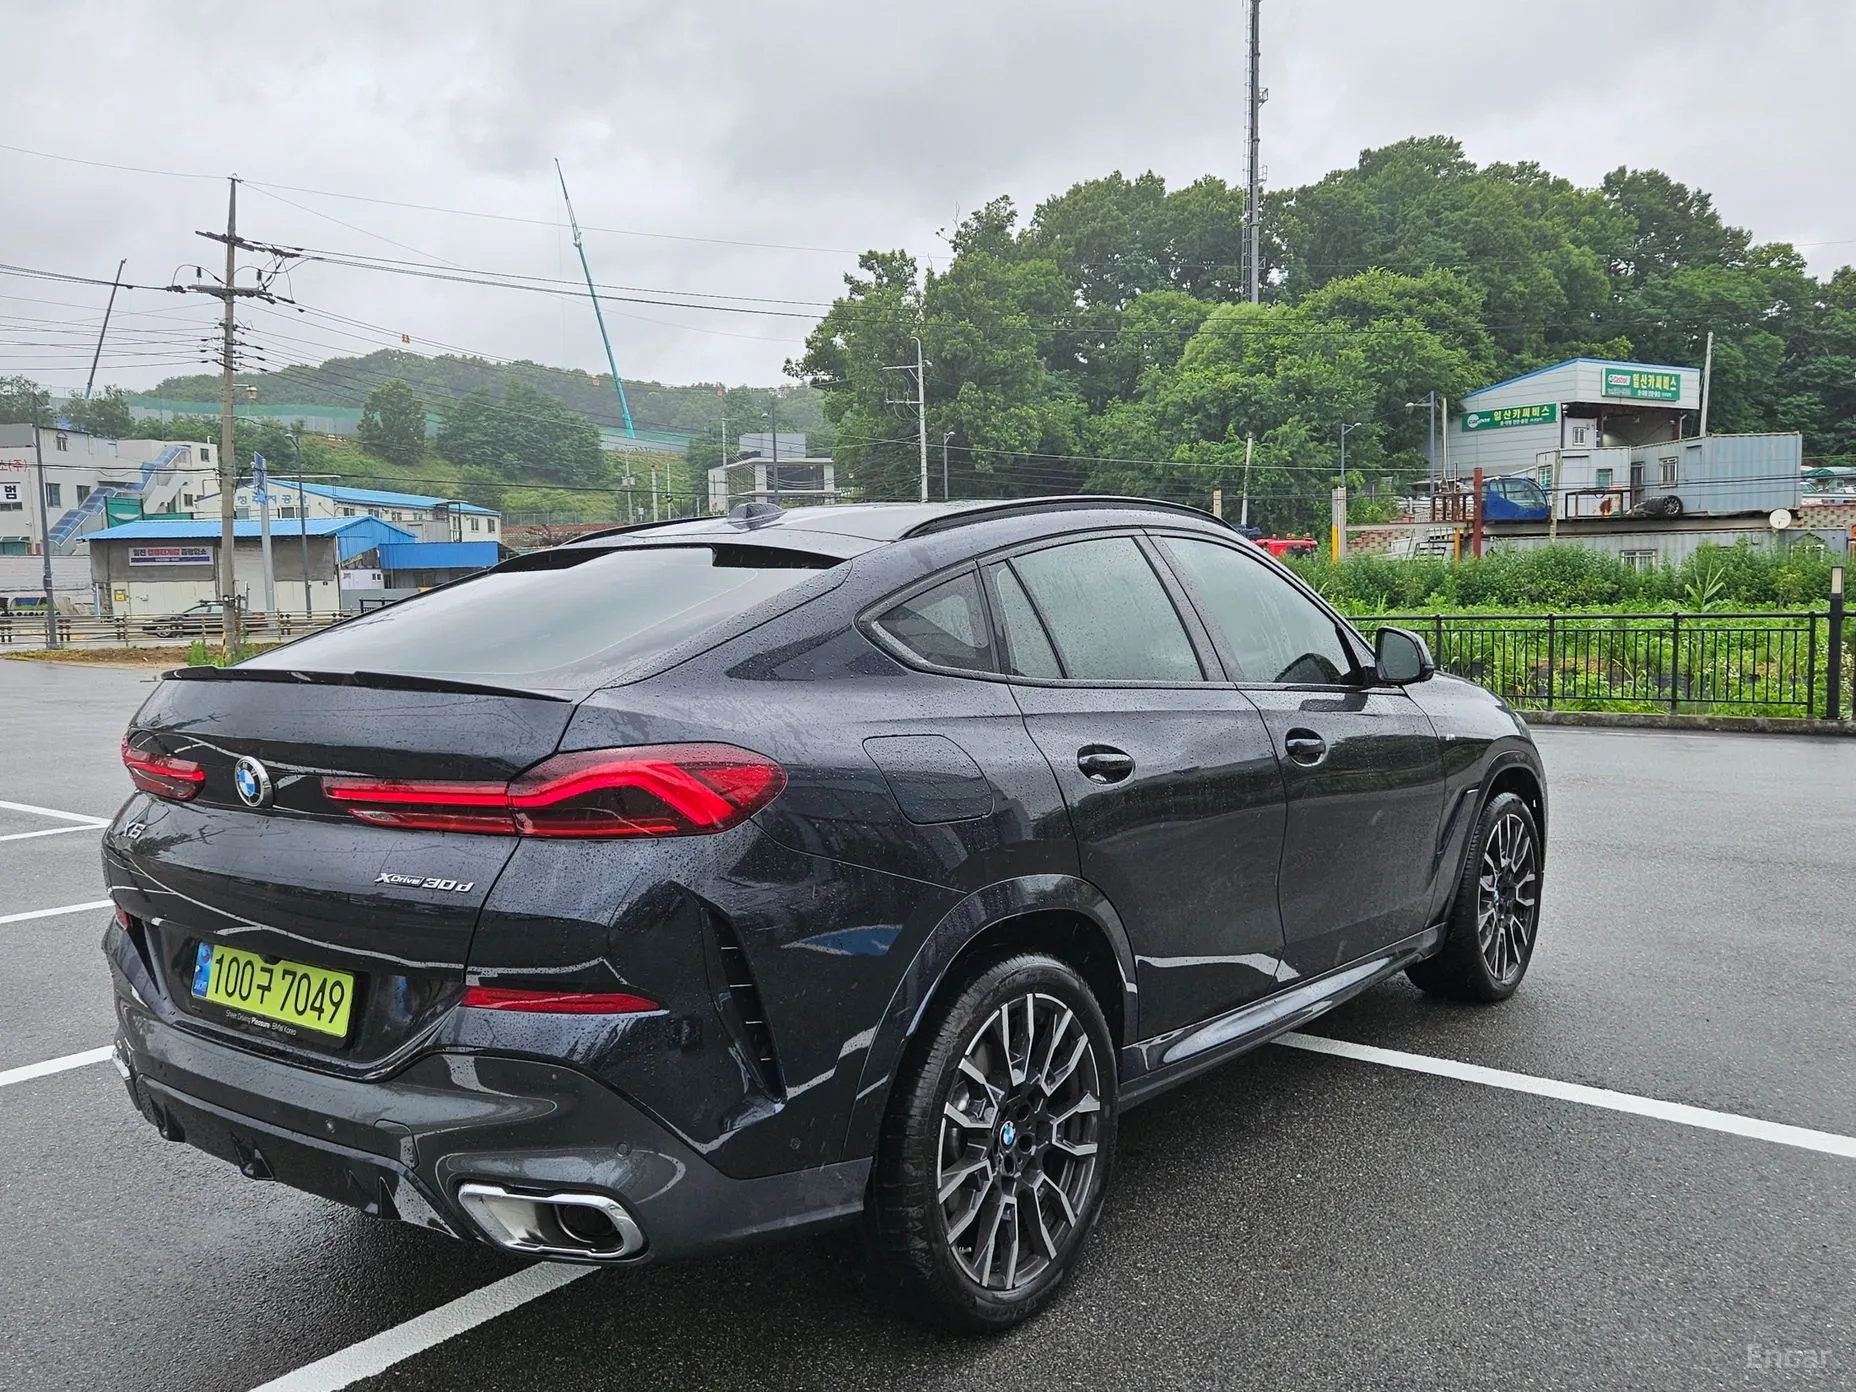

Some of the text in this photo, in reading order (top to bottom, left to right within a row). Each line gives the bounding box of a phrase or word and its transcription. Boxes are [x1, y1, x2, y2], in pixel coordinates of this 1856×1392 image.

[4, 485, 17, 500] 범
[122, 820, 147, 840] X6
[422, 877, 475, 894] 30d
[215, 953, 345, 1024] 100구 7049
